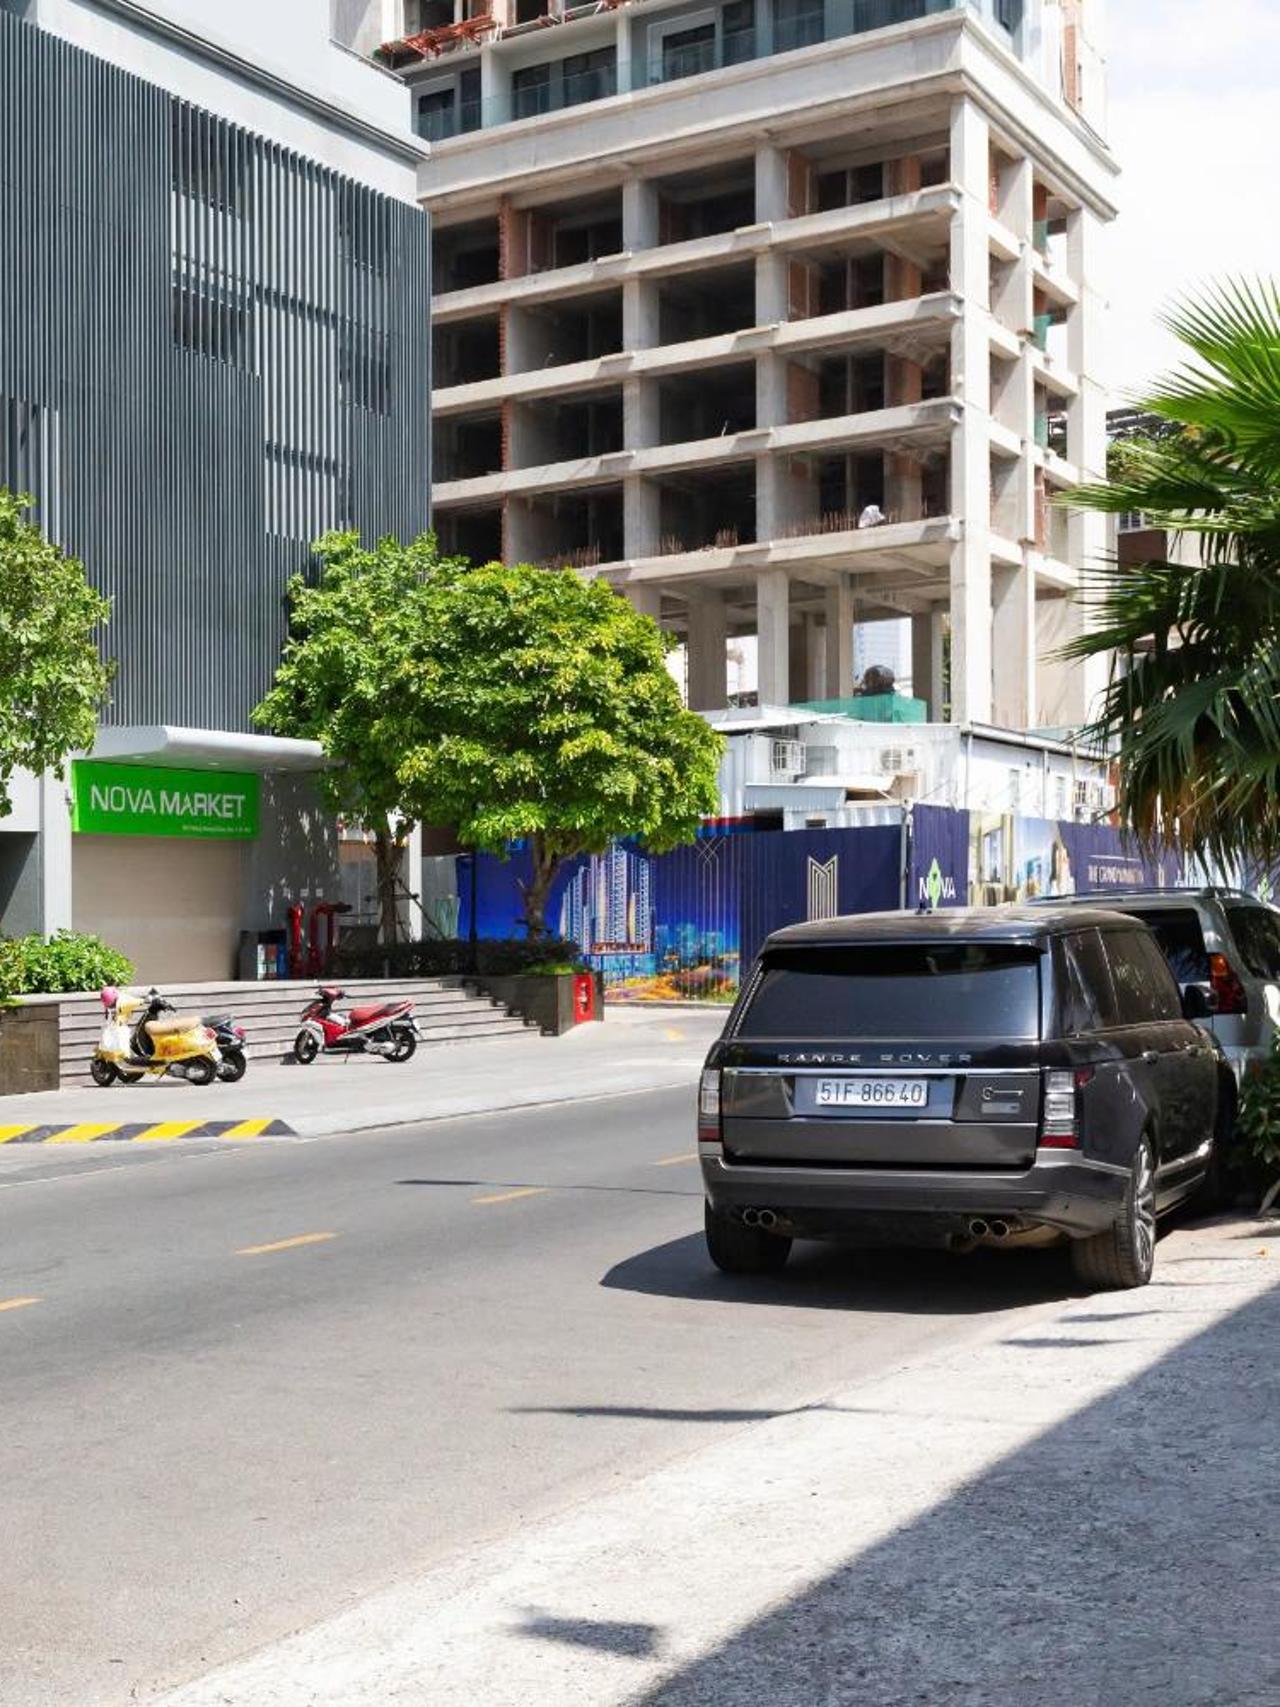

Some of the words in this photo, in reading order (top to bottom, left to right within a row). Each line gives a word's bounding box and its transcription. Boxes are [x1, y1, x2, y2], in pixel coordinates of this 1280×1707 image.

[91, 785, 156, 815] NOVA
[160, 790, 245, 818] MARKET
[778, 1053, 862, 1063] RANGE
[880, 1053, 973, 1063] ROVER
